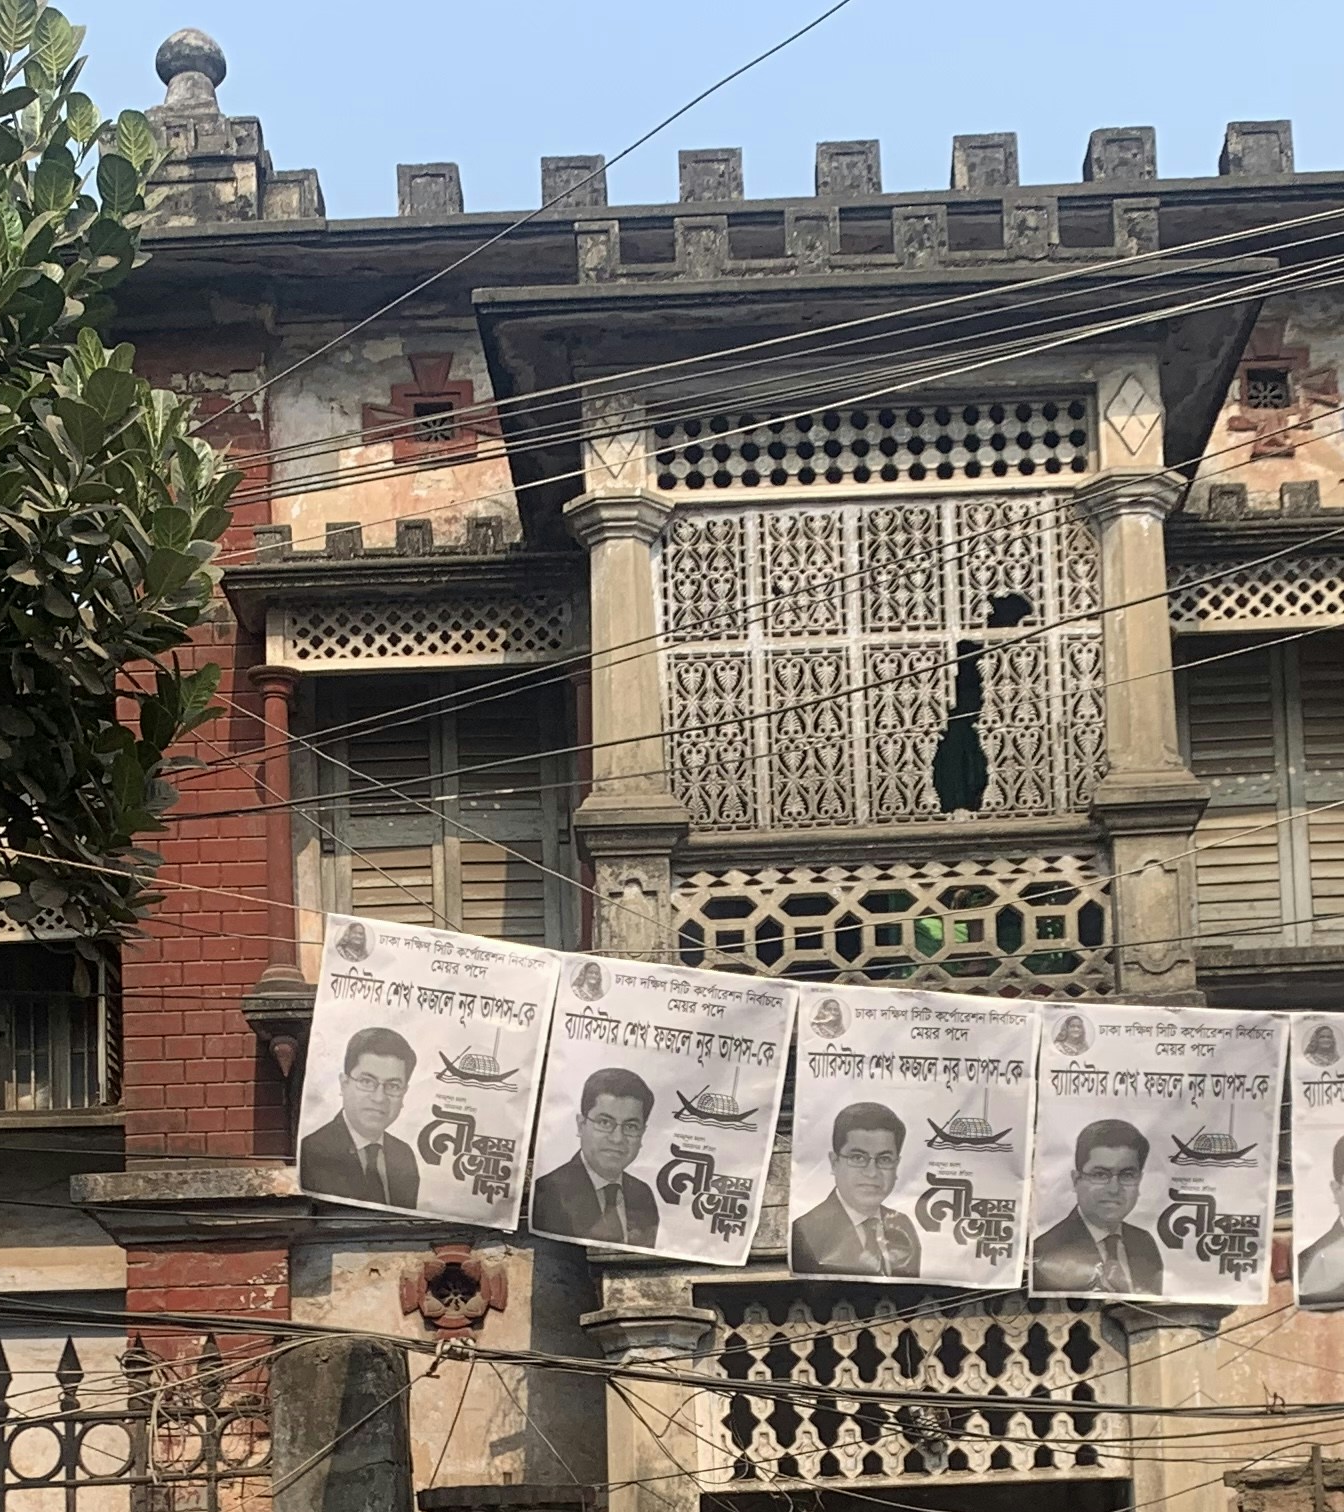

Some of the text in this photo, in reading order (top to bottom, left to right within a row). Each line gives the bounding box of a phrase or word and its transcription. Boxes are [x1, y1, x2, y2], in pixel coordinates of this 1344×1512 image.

[668, 999, 726, 1017] মেয়র পদে
[564, 1006, 777, 1067] ব্যারিস্টার শেখ ফজলে নূর তাপস-কে
[911, 1028, 969, 1040] মেয়র পদে
[1156, 1044, 1216, 1056] মেয়র পদে
[808, 1044, 1024, 1092] ব্যারিস্টার শেখ ফজলে নূর তাপস-কে
[1051, 1061, 1271, 1108] ব্যারিস্টার শেখ ফজলে নূর তাপস-কে
[656, 1143, 753, 1206] নৌকায়
[692, 1190, 750, 1220] ভোট
[915, 1172, 1016, 1232] নৌকায়
[1157, 1188, 1260, 1249] নৌকায়
[710, 1212, 745, 1242] দিন
[953, 1212, 1015, 1245] ভোট
[975, 1237, 1014, 1266] দিন
[1196, 1228, 1258, 1261] ভোট
[1218, 1252, 1257, 1281] দিন
